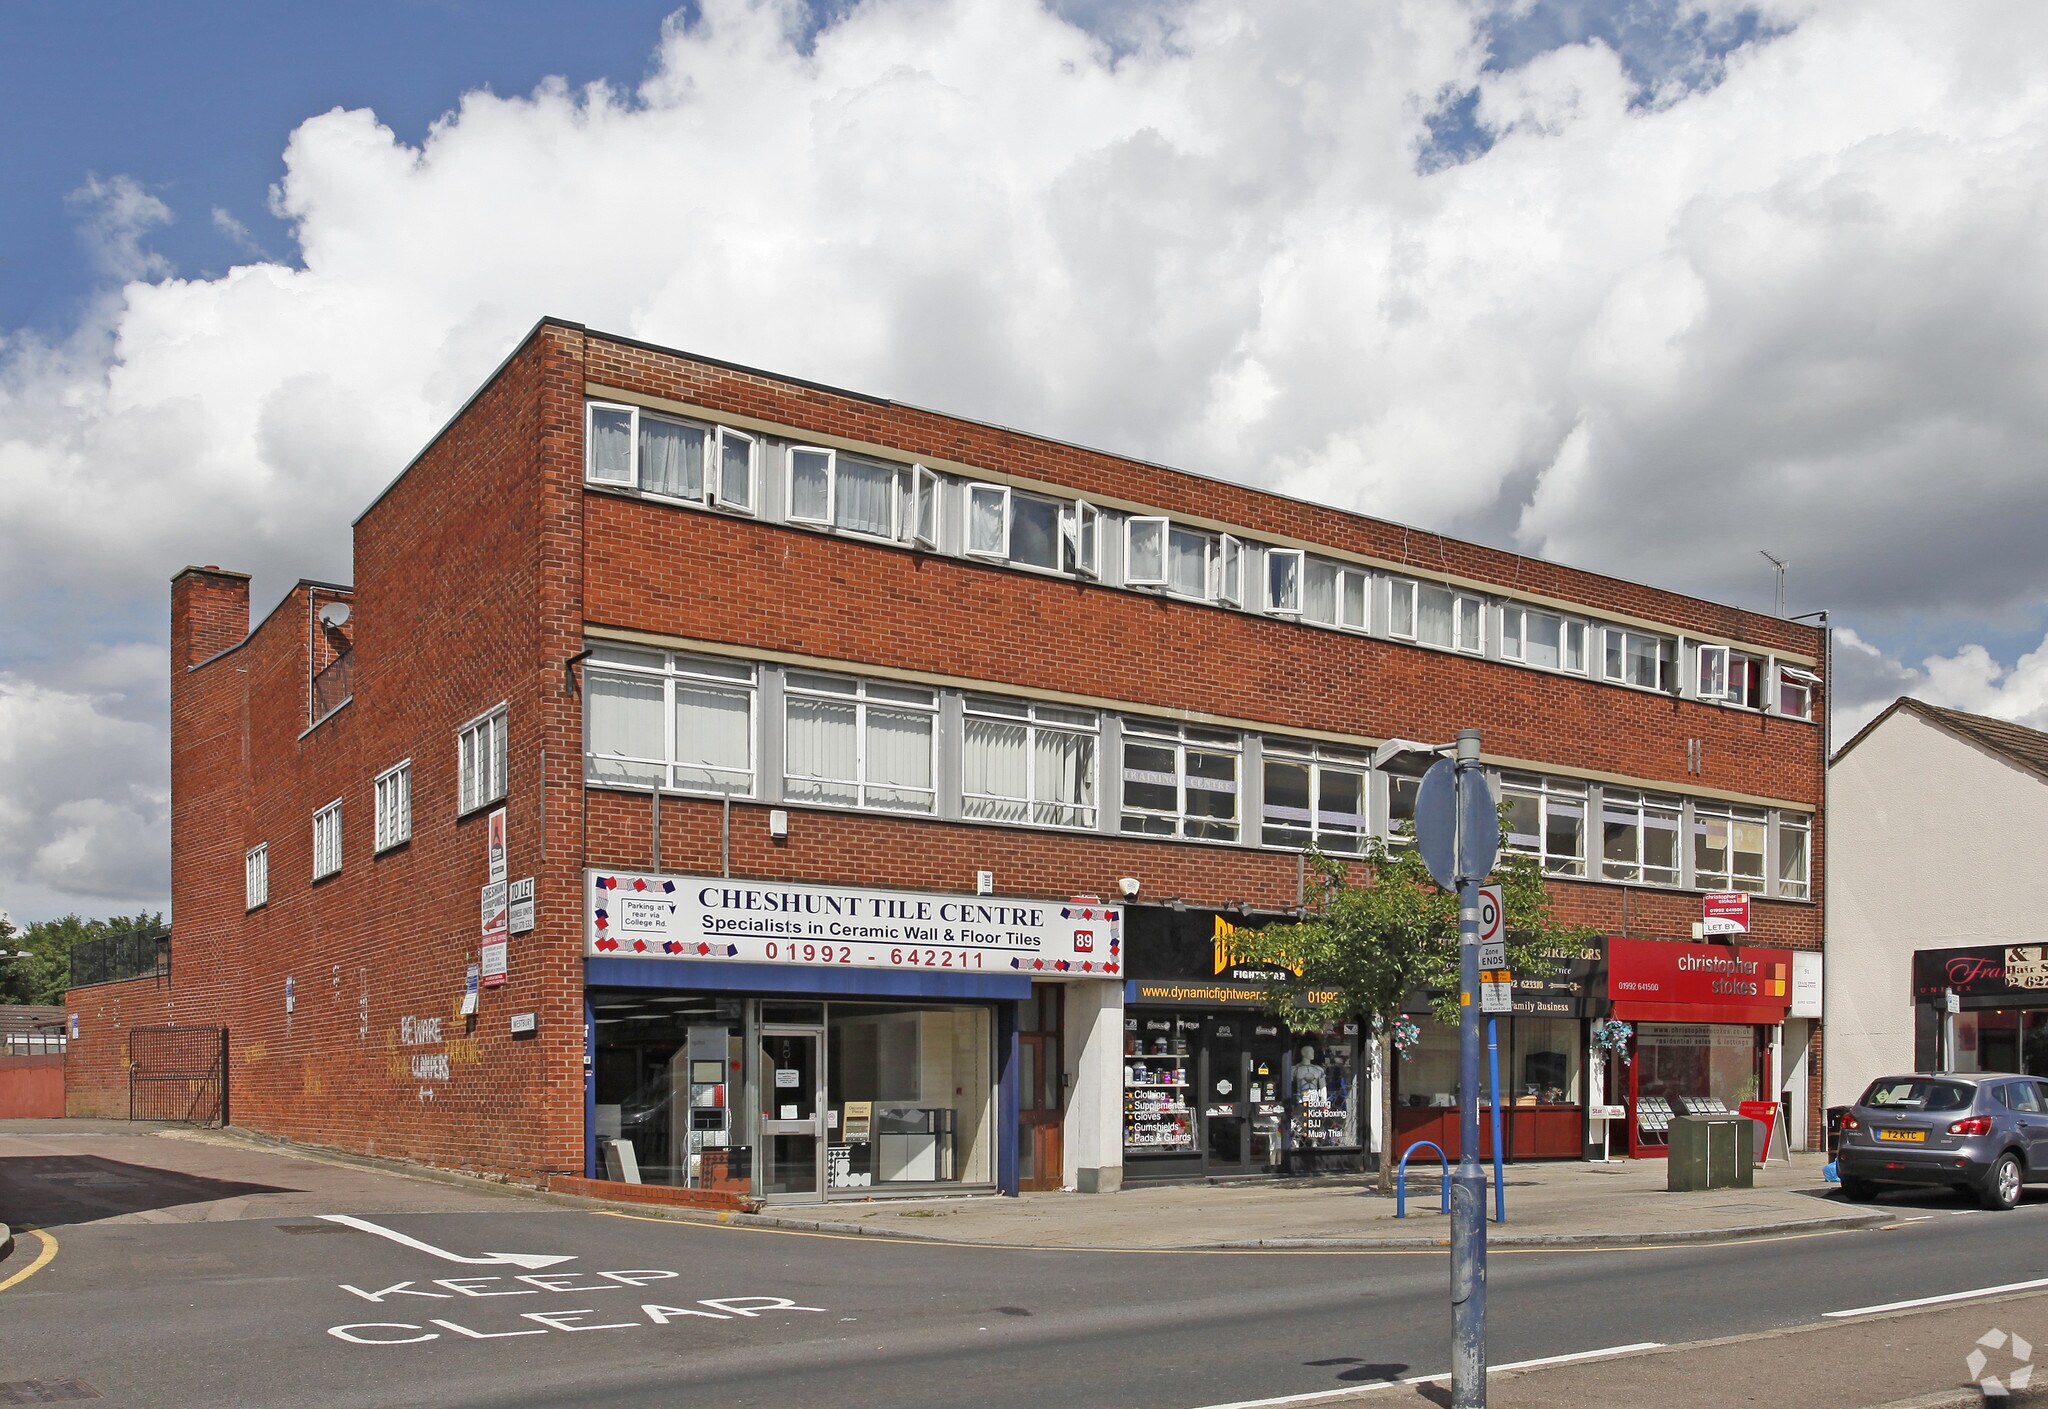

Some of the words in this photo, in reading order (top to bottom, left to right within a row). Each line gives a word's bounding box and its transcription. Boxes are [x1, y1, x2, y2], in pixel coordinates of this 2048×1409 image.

[1124, 770, 1177, 785] TRAINING
[512, 884, 519, 900] TO
[521, 880, 532, 897] LET
[627, 902, 655, 912] Parking
[656, 904, 664, 912] at
[698, 887, 861, 916] CHESHUNT
[869, 898, 932, 920] TILE
[940, 903, 1045, 928] CENTRE
[625, 918, 653, 929] College
[702, 915, 801, 934] Specialists
[808, 921, 824, 934] in
[829, 922, 899, 939] Ceramic
[904, 926, 938, 941] Wall
[944, 928, 955, 942] &
[961, 930, 1001, 944] Floor
[1005, 932, 1041, 946] Tiles
[1076, 934, 1092, 948] 89
[765, 942, 851, 964] 01992
[890, 948, 983, 968] 642211
[1485, 948, 1499, 956] Zone
[2008, 947, 2029, 962] &
[1482, 956, 1504, 966] ENDS
[1678, 952, 1759, 977] christopher
[2006, 966, 2036, 975] Hair
[1520, 980, 1544, 989] 623310
[1618, 982, 1637, 990] 01992
[1638, 982, 1658, 991] 641500
[1712, 978, 1758, 996] stokes
[1920, 986, 1972, 994] UNIEX
[1537, 1002, 1569, 1012] Business
[401, 1015, 442, 1046] BEWARE
[445, 1038, 484, 1066] PARKING
[1134, 1090, 1166, 1100] Clothing
[1134, 1101, 1185, 1112] Supplements
[1308, 1100, 1332, 1110] Boxing
[1134, 1112, 1161, 1121] Gloves
[1308, 1110, 1322, 1118] Kick
[1324, 1110, 1347, 1120] Boxing
[1134, 1122, 1180, 1132] Gumshields
[1308, 1120, 1321, 1128] BJJ
[1134, 1133, 1154, 1142] Pads
[1156, 1134, 1161, 1142] &
[1163, 1133, 1192, 1142] Guards
[1308, 1130, 1327, 1140] Muay
[1328, 1129, 1342, 1138] Thai
[1887, 1130, 1898, 1139] T2
[1900, 1131, 1917, 1140] KTC
[338, 1270, 680, 1302] KEEP
[327, 1296, 827, 1345] CLEAR
